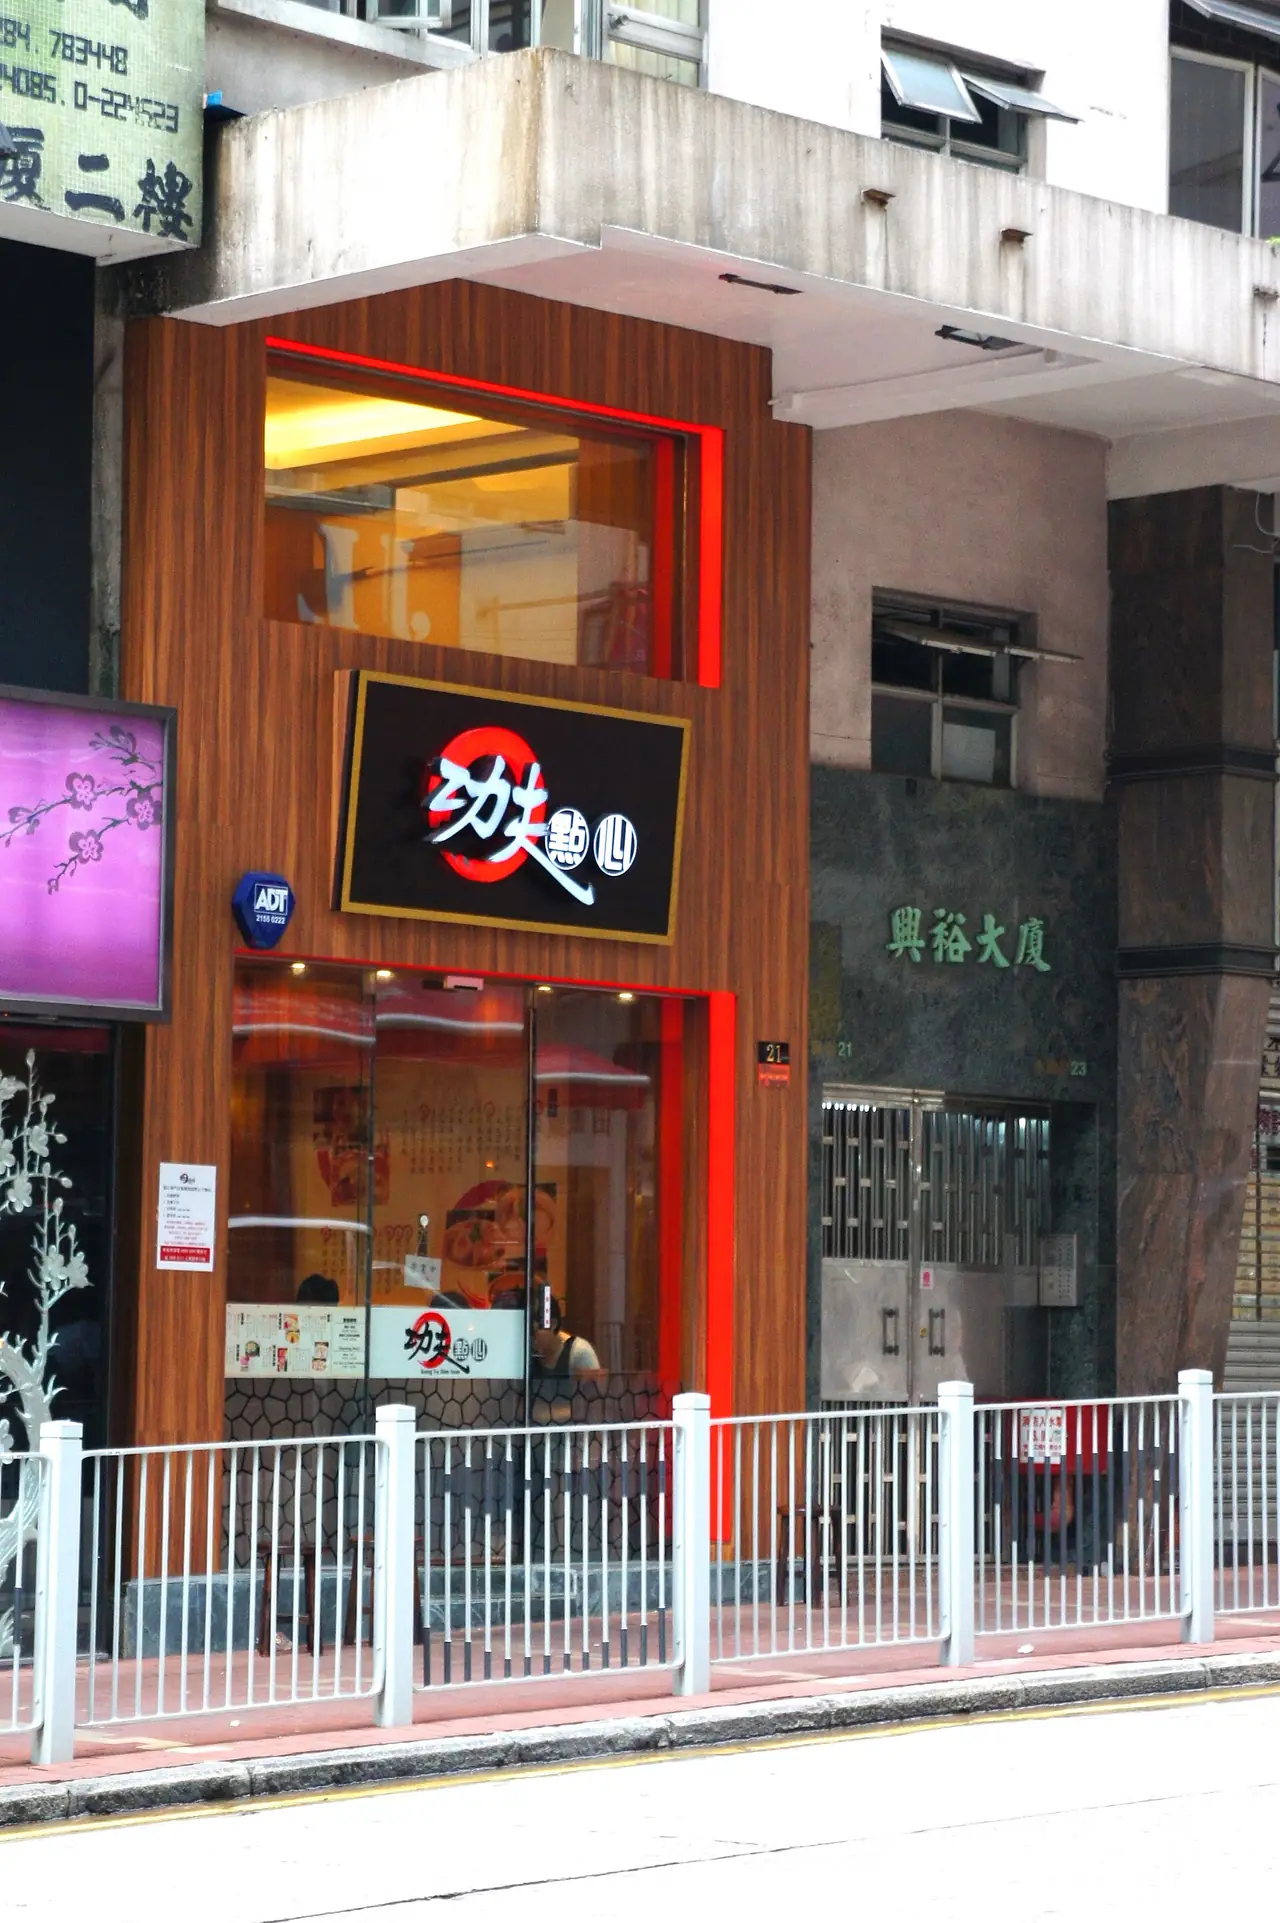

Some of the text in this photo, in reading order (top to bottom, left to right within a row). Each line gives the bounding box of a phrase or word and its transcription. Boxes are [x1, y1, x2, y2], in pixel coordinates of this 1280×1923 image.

[0, 17, 128, 76] 84. 783448
[0, 63, 65, 106] 4085.
[431, 755, 638, 905] 功夫點心
[254, 887, 288, 912] ADT
[885, 906, 1051, 972] 興裕大廈
[766, 1043, 781, 1063] 21
[837, 1041, 853, 1058] 21
[1070, 1060, 1087, 1077] 23
